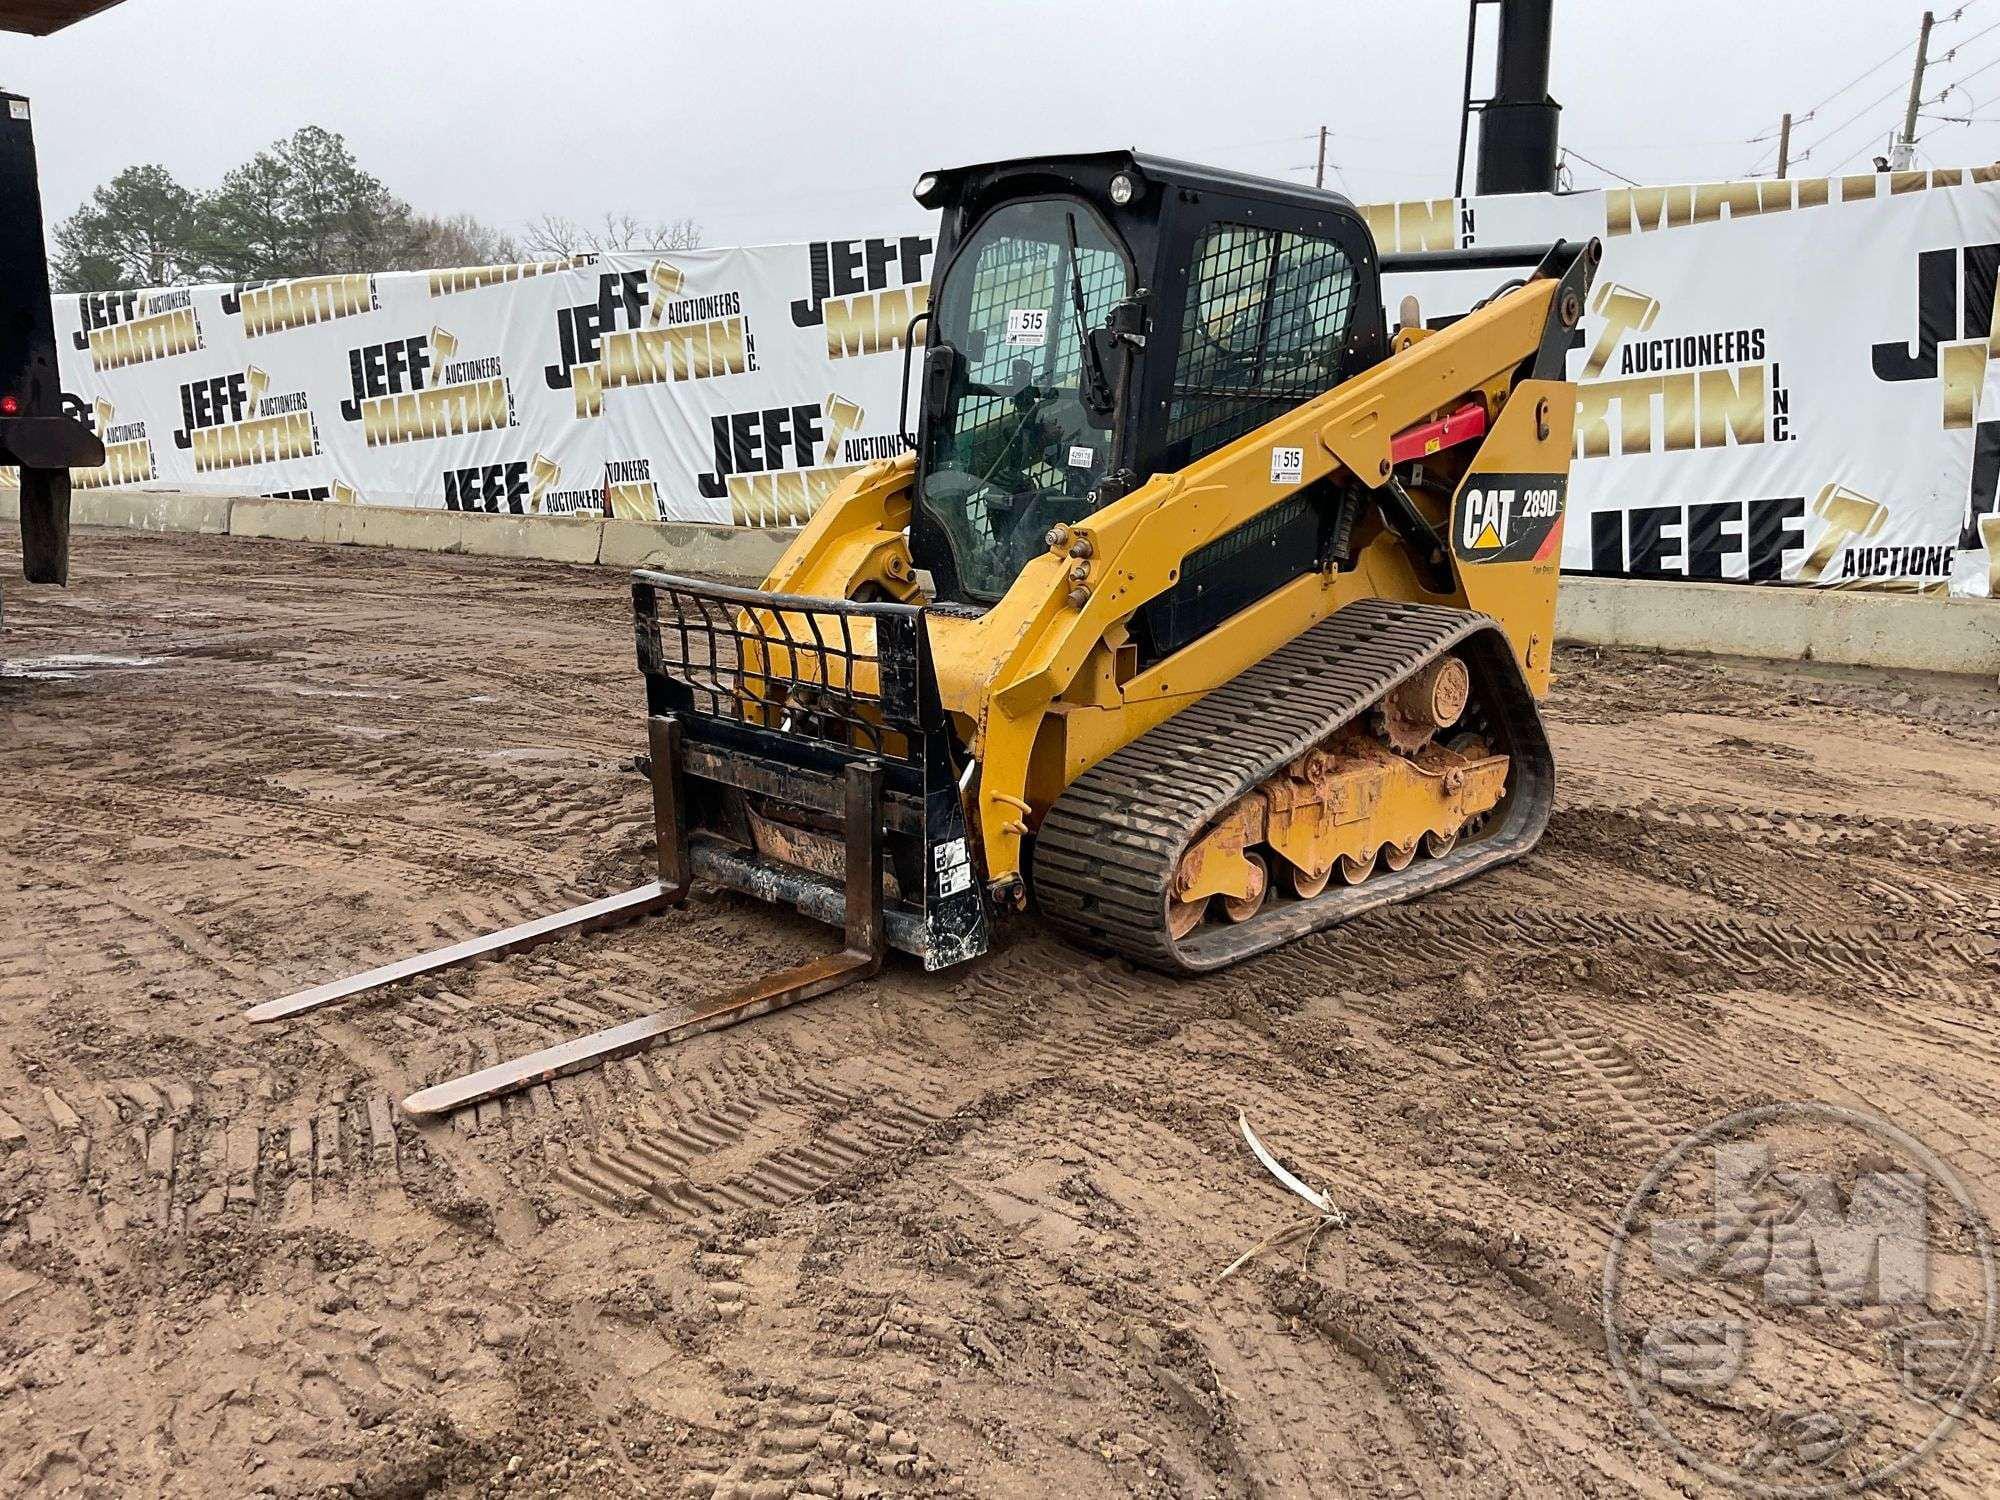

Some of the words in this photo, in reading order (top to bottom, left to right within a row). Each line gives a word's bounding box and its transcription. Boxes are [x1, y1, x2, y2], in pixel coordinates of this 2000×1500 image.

[149, 289, 191, 315] AUCTIONEERS
[239, 274, 371, 339] MARTIN
[669, 291, 740, 325] AUCTIONEERS
[1022, 313, 1043, 330] 515
[89, 309, 198, 372] MARTIN
[744, 315, 760, 372] INC.
[1621, 328, 1764, 374] AUCTIONEERS
[340, 335, 430, 422] JEFF
[445, 356, 501, 385] AUCTIONEERS
[1772, 363, 1797, 441] INC.
[107, 421, 146, 444] AUCTIONEERS
[173, 372, 247, 449] JEFF
[260, 391, 308, 417] AUCTIONEERS
[362, 378, 508, 448] MARTIN
[1574, 365, 1765, 458] RTIN
[192, 412, 313, 473] MARTIN
[698, 404, 824, 498] JEFF
[1283, 451, 1300, 468] 515
[1463, 489, 1515, 549] CAT
[1521, 489, 1557, 517] 289D
